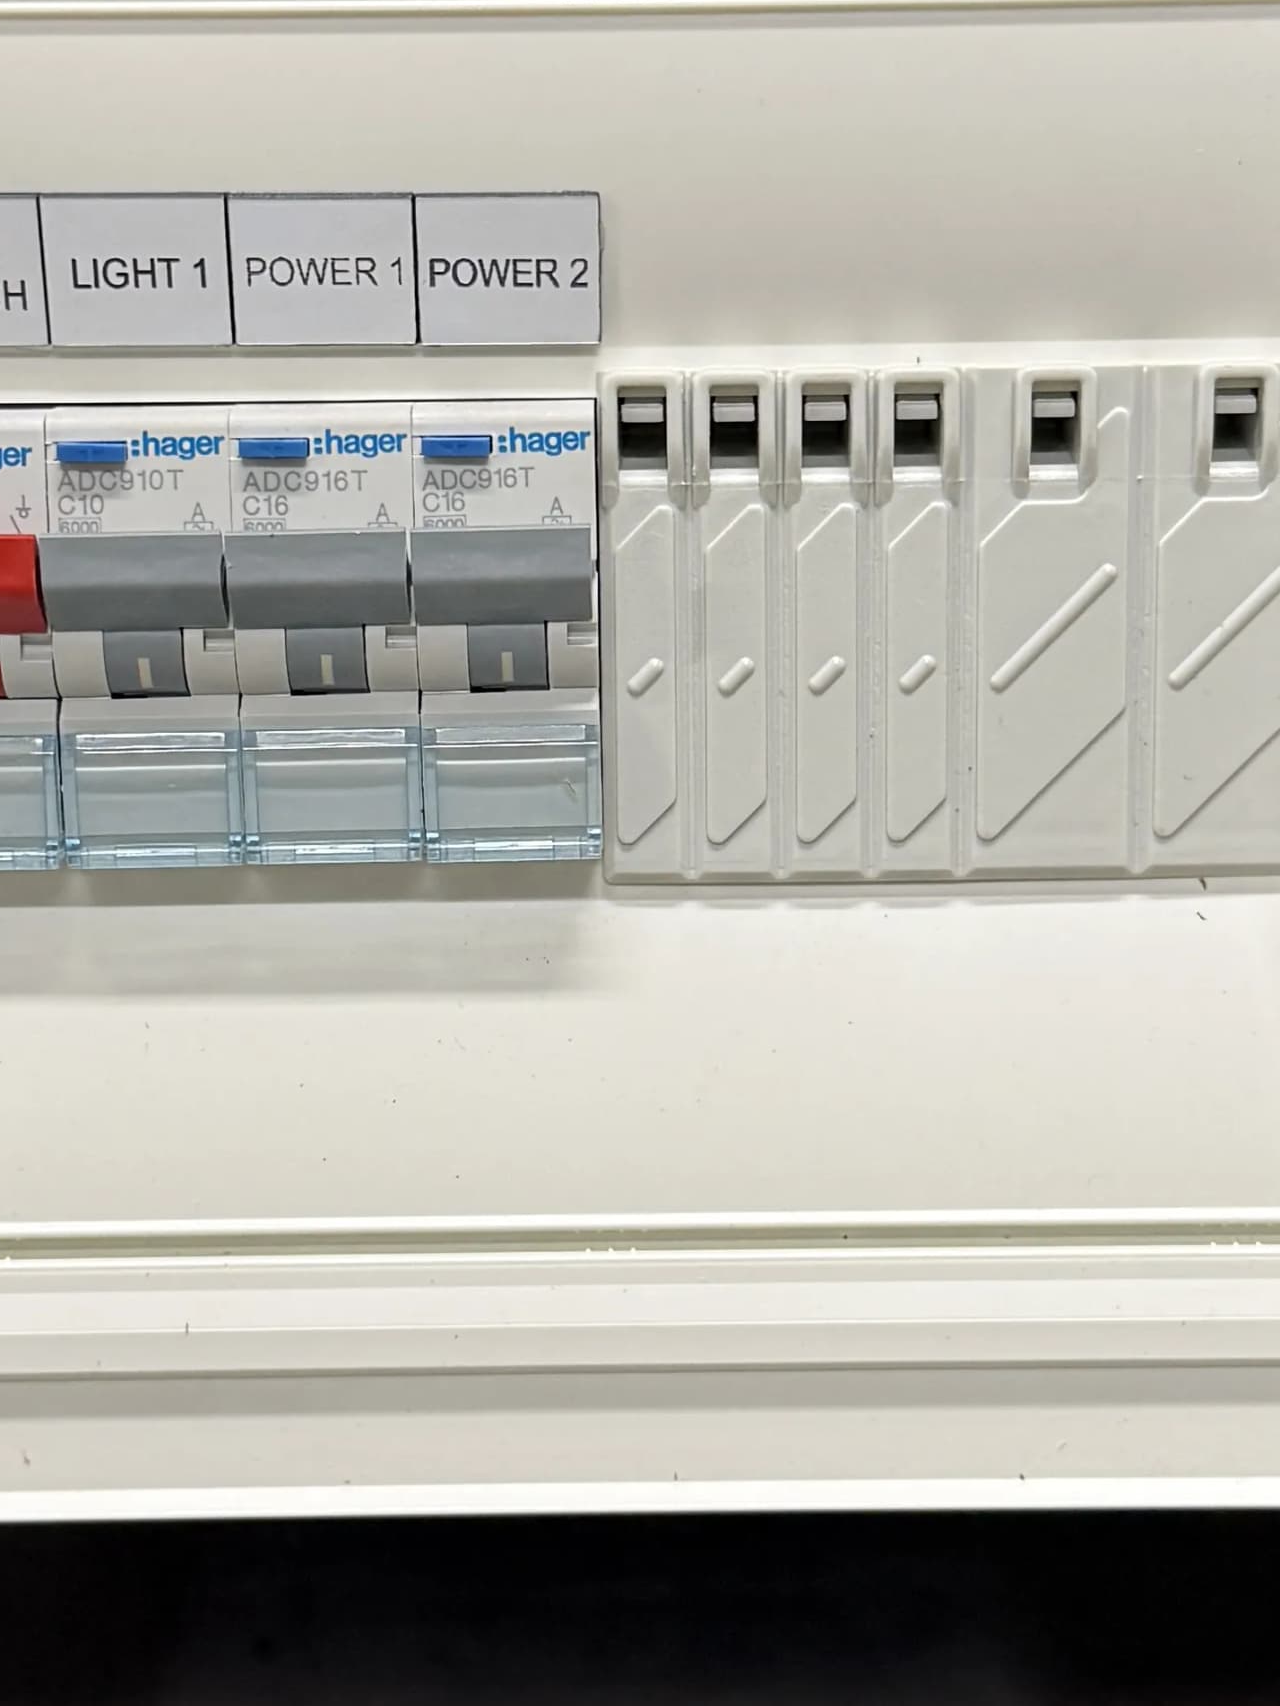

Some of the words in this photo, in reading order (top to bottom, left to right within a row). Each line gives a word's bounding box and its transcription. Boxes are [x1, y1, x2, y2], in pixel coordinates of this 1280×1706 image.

[71, 257, 180, 289] LIGHT
[193, 258, 207, 288] 1
[246, 256, 378, 287] POWER
[390, 256, 403, 285] 1
[428, 258, 560, 288] POWER
[570, 258, 589, 288] 2
[57, 469, 184, 492] ADC910T
[243, 470, 368, 492] ADC916T
[422, 467, 535, 491] ADC916T
[58, 494, 105, 515] C10
[243, 495, 289, 516] C16
[423, 492, 465, 513] C16
[61, 520, 100, 533] 6000
